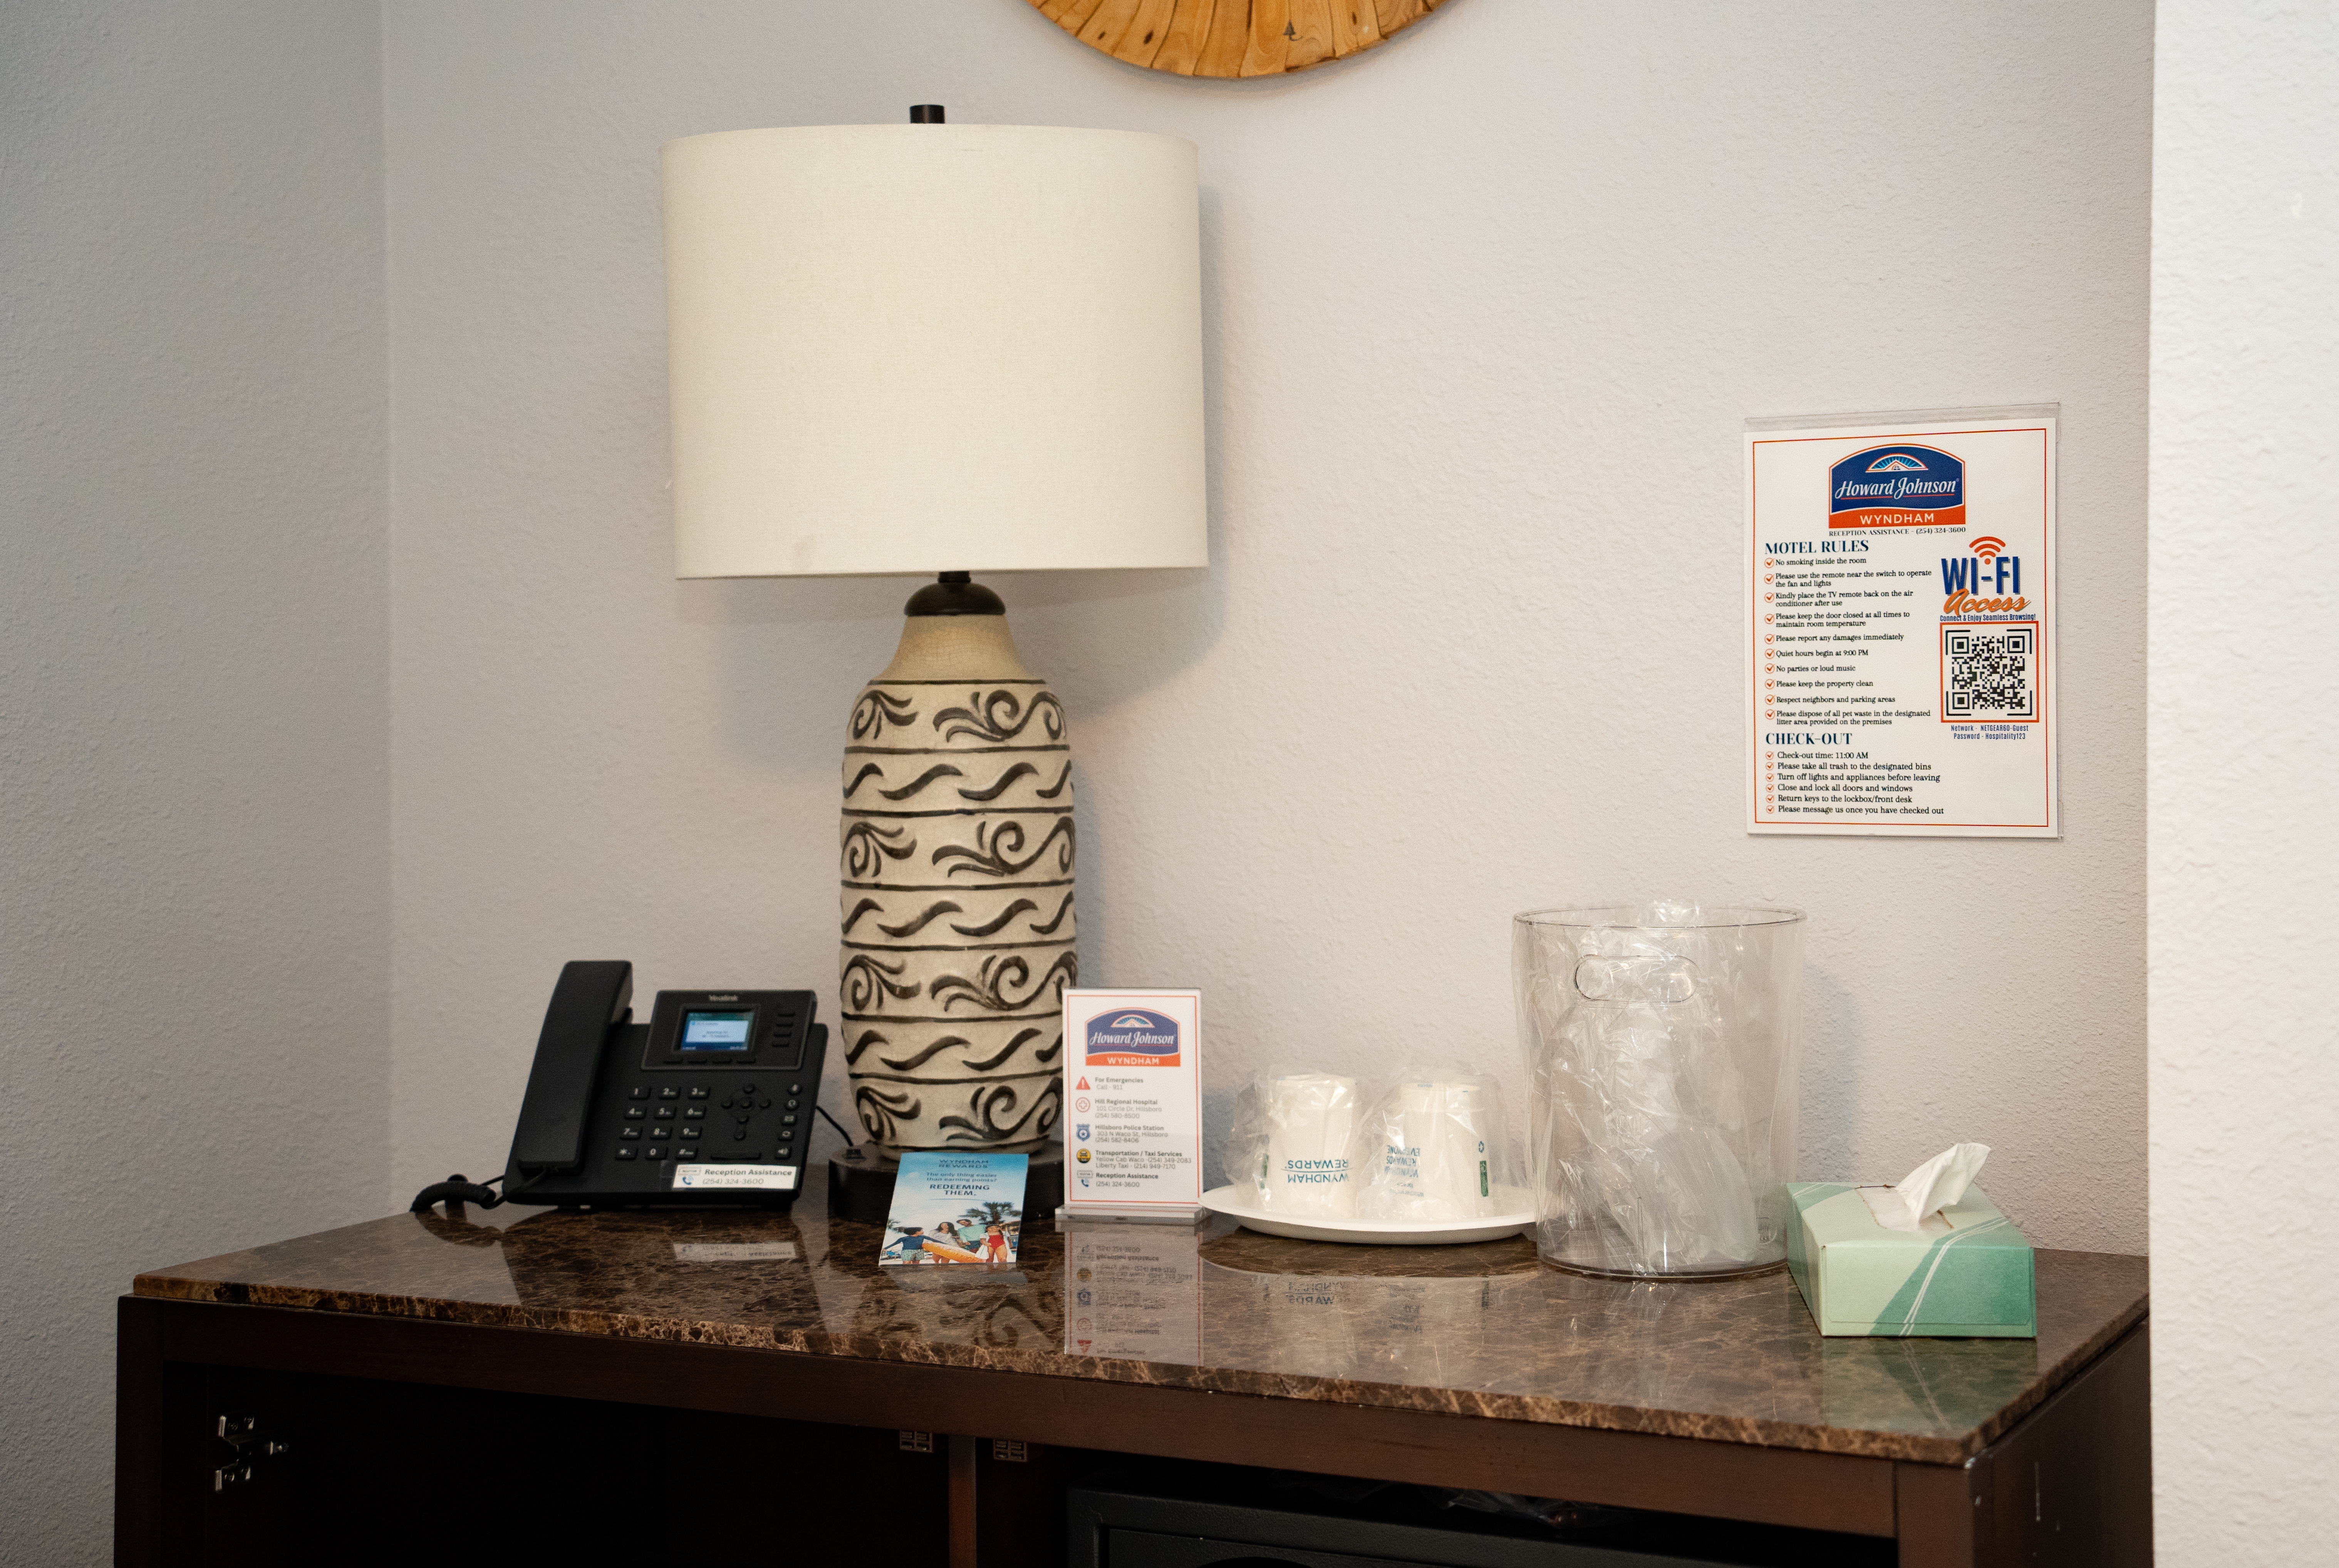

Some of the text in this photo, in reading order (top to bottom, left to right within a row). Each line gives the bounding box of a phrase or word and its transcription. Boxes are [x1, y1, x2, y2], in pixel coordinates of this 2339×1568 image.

[1835, 477, 1956, 500] Howard Johnson
[1859, 513, 1934, 525] WYNDHAM
[1766, 540, 1869, 554] MOTEL RULES
[1786, 558, 1814, 567] smoking
[1941, 556, 2020, 595] WI-FI
[1776, 592, 1796, 600] Kindly
[1797, 592, 1814, 600] place
[1943, 588, 2031, 616] Access
[1967, 614, 1982, 622] Enjoy
[1833, 634, 1861, 642] damages
[1863, 633, 1904, 641] immediately
[1776, 650, 1794, 658] Quiet
[1815, 649, 1834, 657] begin
[1776, 696, 1801, 704] Respect
[1802, 696, 1835, 704] neighbors
[1851, 696, 1876, 704] parking
[1798, 710, 1823, 718] dispose
[1894, 710, 1931, 718] designated
[1809, 718, 1838, 726] provided
[1862, 718, 1892, 726] premises
[1766, 733, 1852, 745] CHECK-OUT
[1873, 762, 1913, 771] designated
[1808, 773, 1828, 782] lights
[1846, 773, 1886, 783] appliances
[1887, 773, 1911, 781] before
[1913, 773, 1941, 783] leaving
[1804, 795, 1820, 803] keys
[1844, 795, 1893, 803] lockbox/front
[1895, 795, 1913, 803] desk
[1802, 807, 1833, 815] message
[1880, 806, 1898, 814] have
[1899, 806, 1930, 814] checked
[1089, 1031, 1174, 1047] Howard Johnson
[1107, 1057, 1159, 1065] WYNDHAM
[1287, 1159, 1348, 1169] REWARDS
[1288, 1173, 1349, 1183] WYNDHAM
